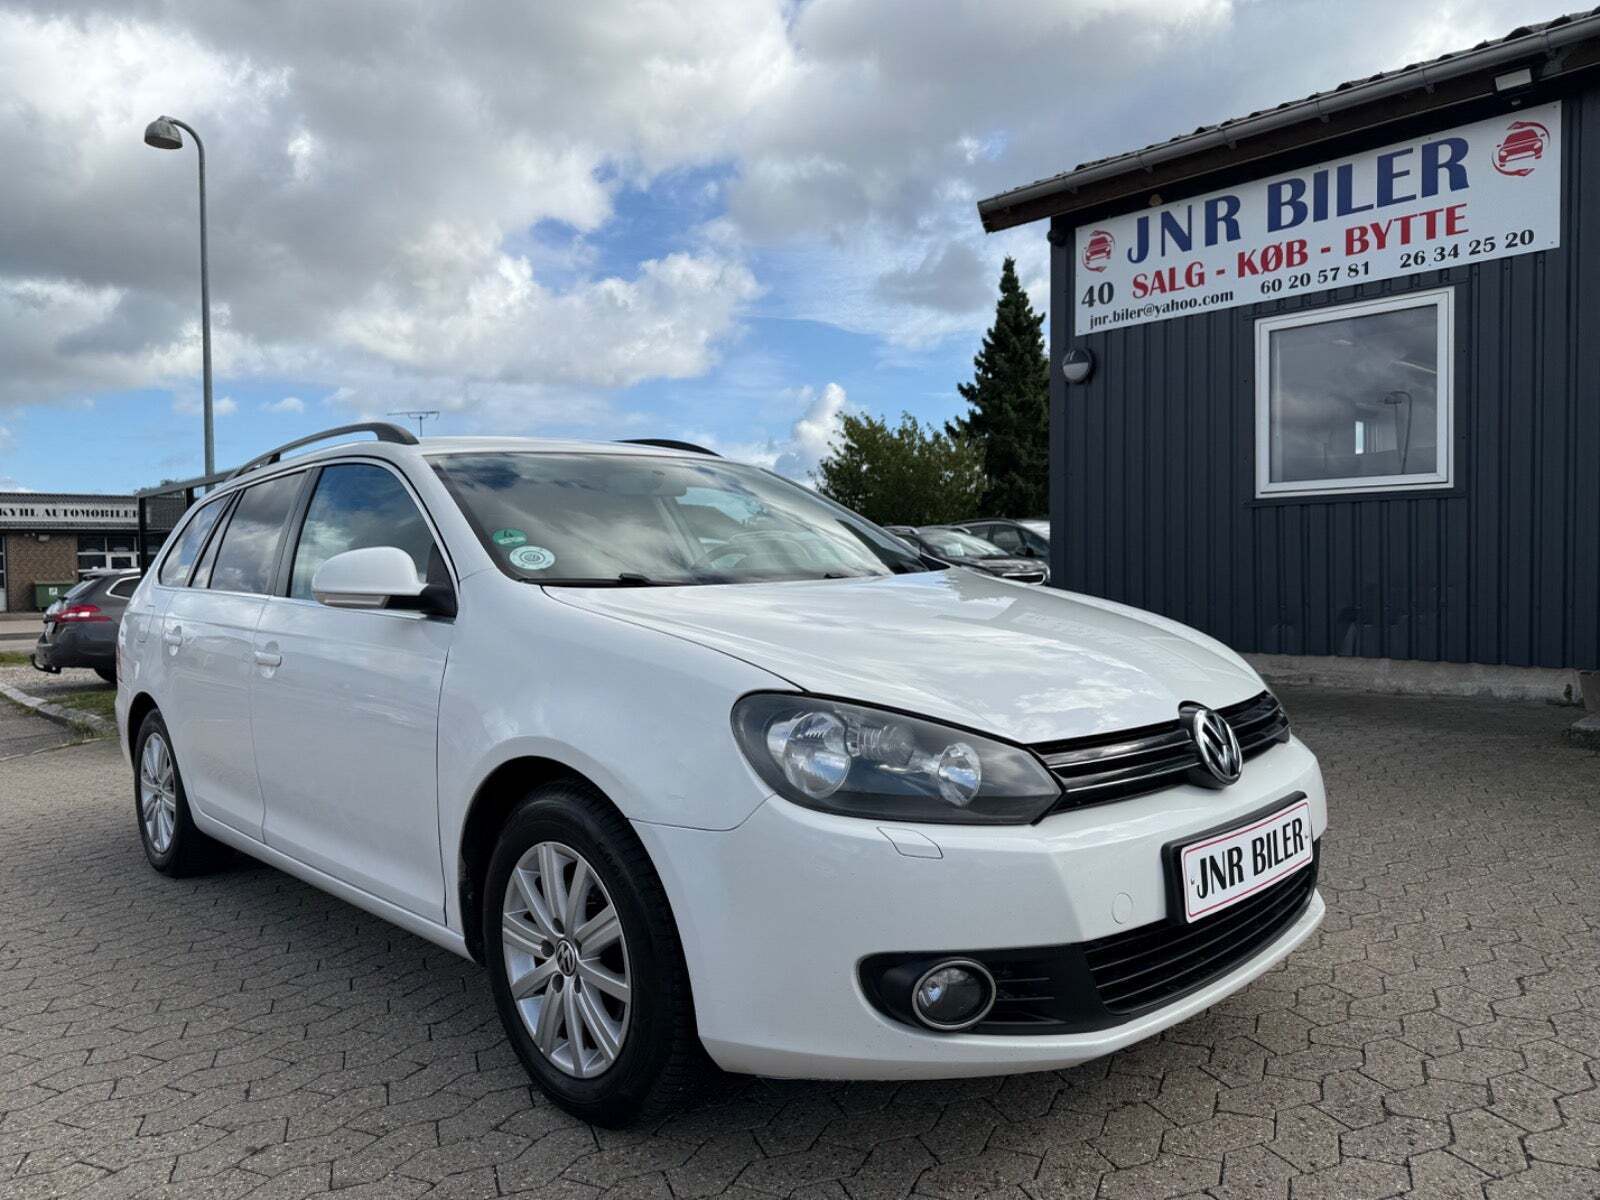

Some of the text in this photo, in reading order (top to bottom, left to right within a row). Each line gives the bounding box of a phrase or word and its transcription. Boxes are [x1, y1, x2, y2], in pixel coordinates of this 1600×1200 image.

[1127, 137, 1470, 265] JNR BILER
[1132, 260, 1206, 299] SALG
[1238, 238, 1309, 280] KØB
[1345, 203, 1469, 257] BYTTE
[1400, 229, 1535, 269] 26 34 25 20
[1081, 281, 1115, 308] 40
[1260, 261, 1370, 295] 60 20 57 81
[1090, 290, 1234, 330] jnr.biler@yahoo.com
[1197, 817, 1305, 899] JNR BILER
